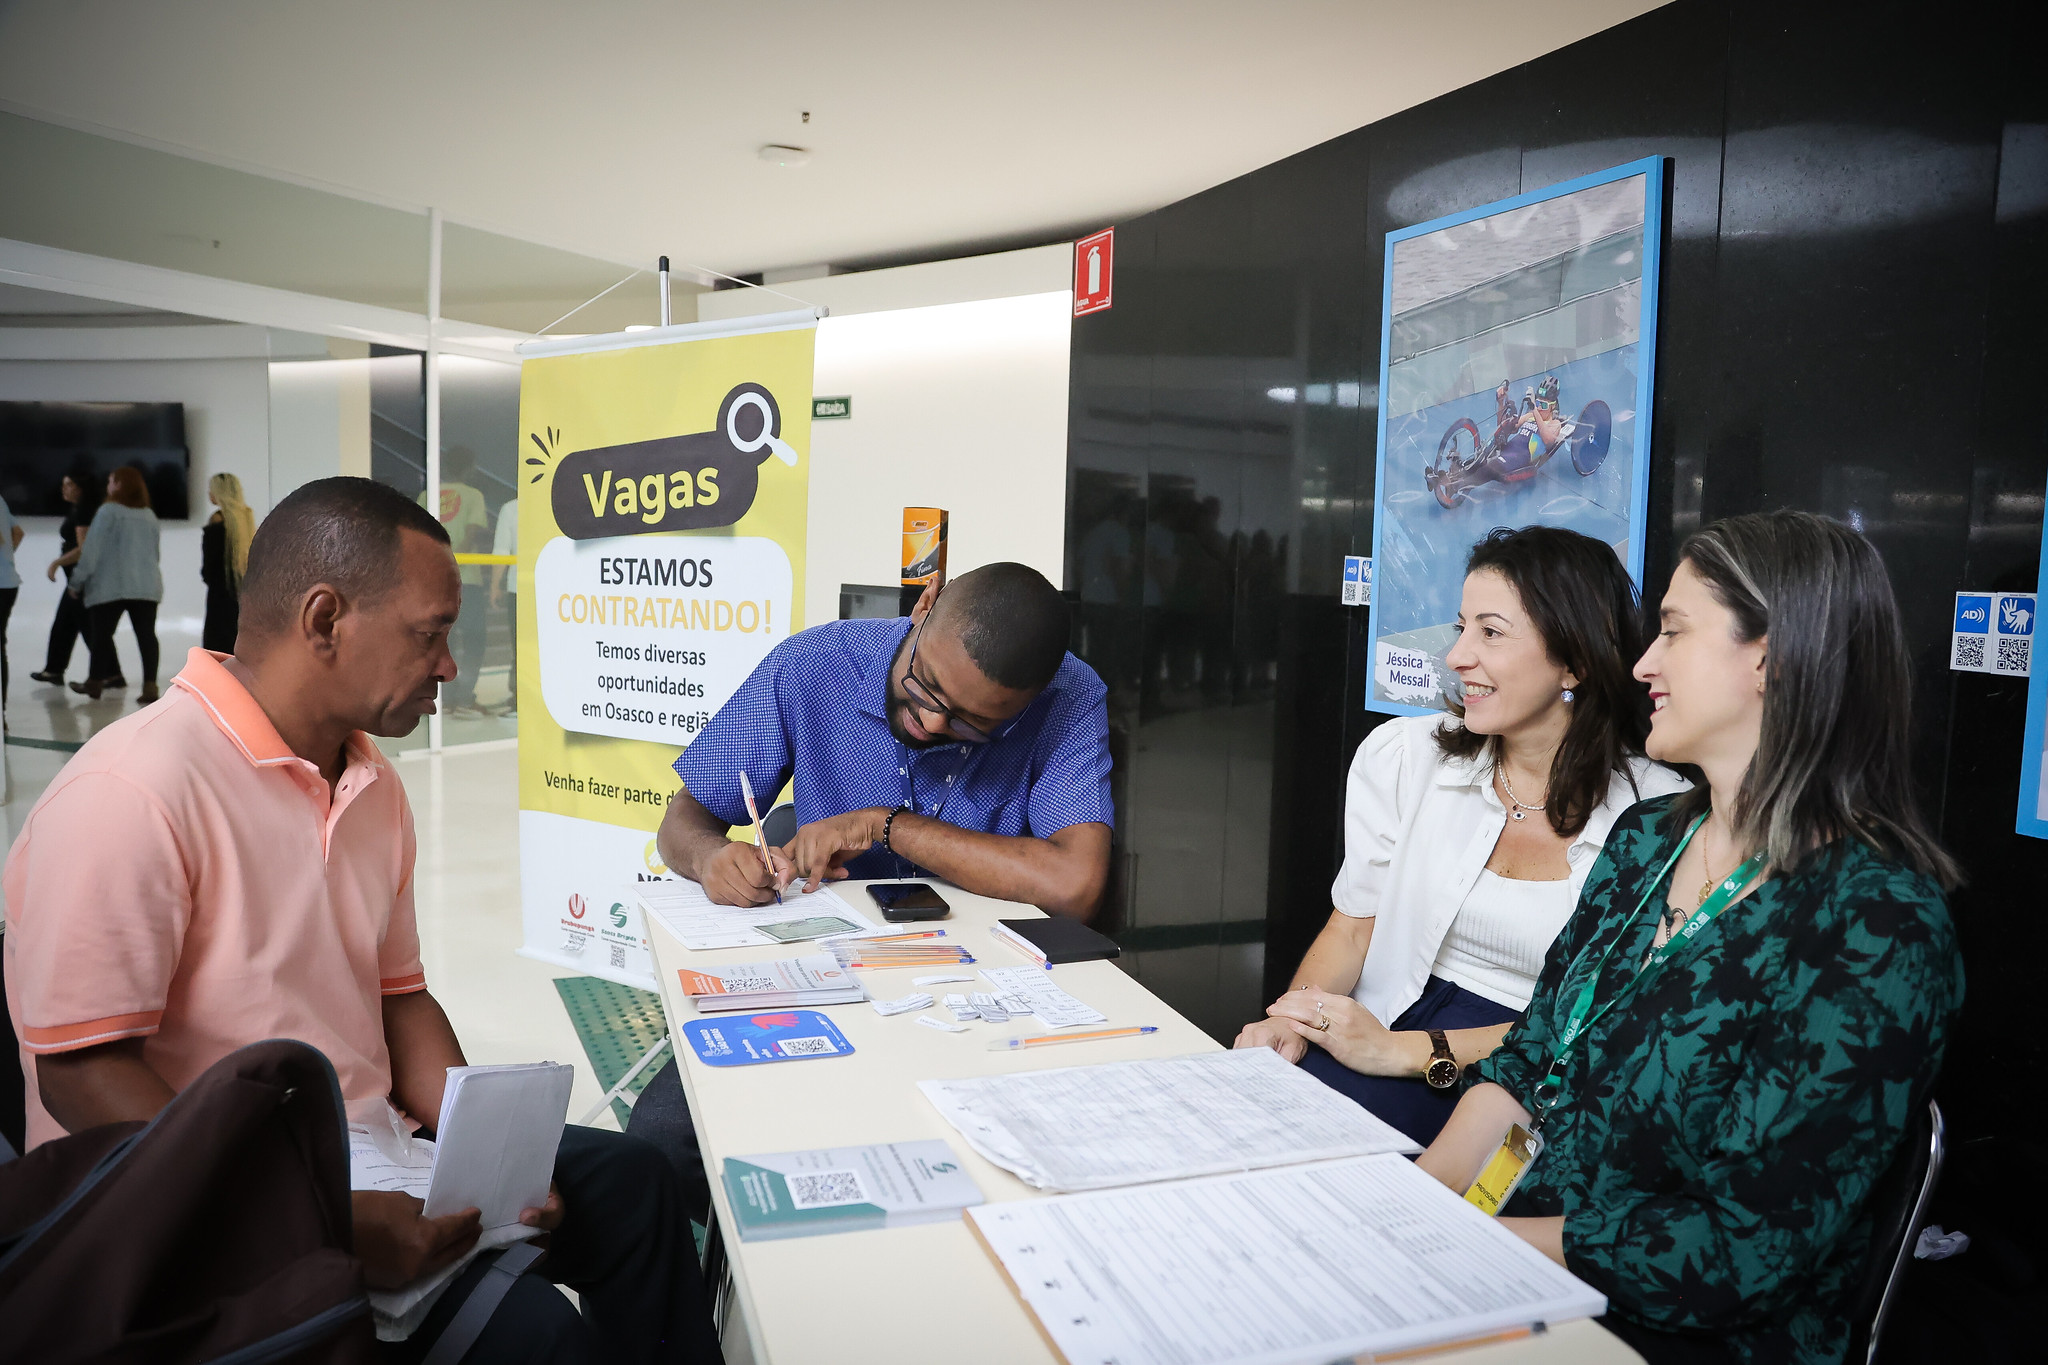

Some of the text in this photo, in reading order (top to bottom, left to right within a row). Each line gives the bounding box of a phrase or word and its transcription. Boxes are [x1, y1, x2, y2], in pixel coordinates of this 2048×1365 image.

[582, 466, 720, 525] Vagas
[600, 557, 713, 588] ESTAMOS
[558, 592, 771, 634] CONTRATANDO!
[1961, 610, 1978, 619] AD
[596, 641, 706, 666] Temos diversas
[1386, 652, 1423, 669] Jéssica
[597, 675, 704, 698] oportunidades
[1390, 670, 1430, 688] Messali
[582, 702, 709, 734] em Osasco e regiã
[544, 770, 676, 807] Venha fazer parte d
[1682, 921, 1700, 939] ISO
[1563, 1028, 1574, 1045] ISO
